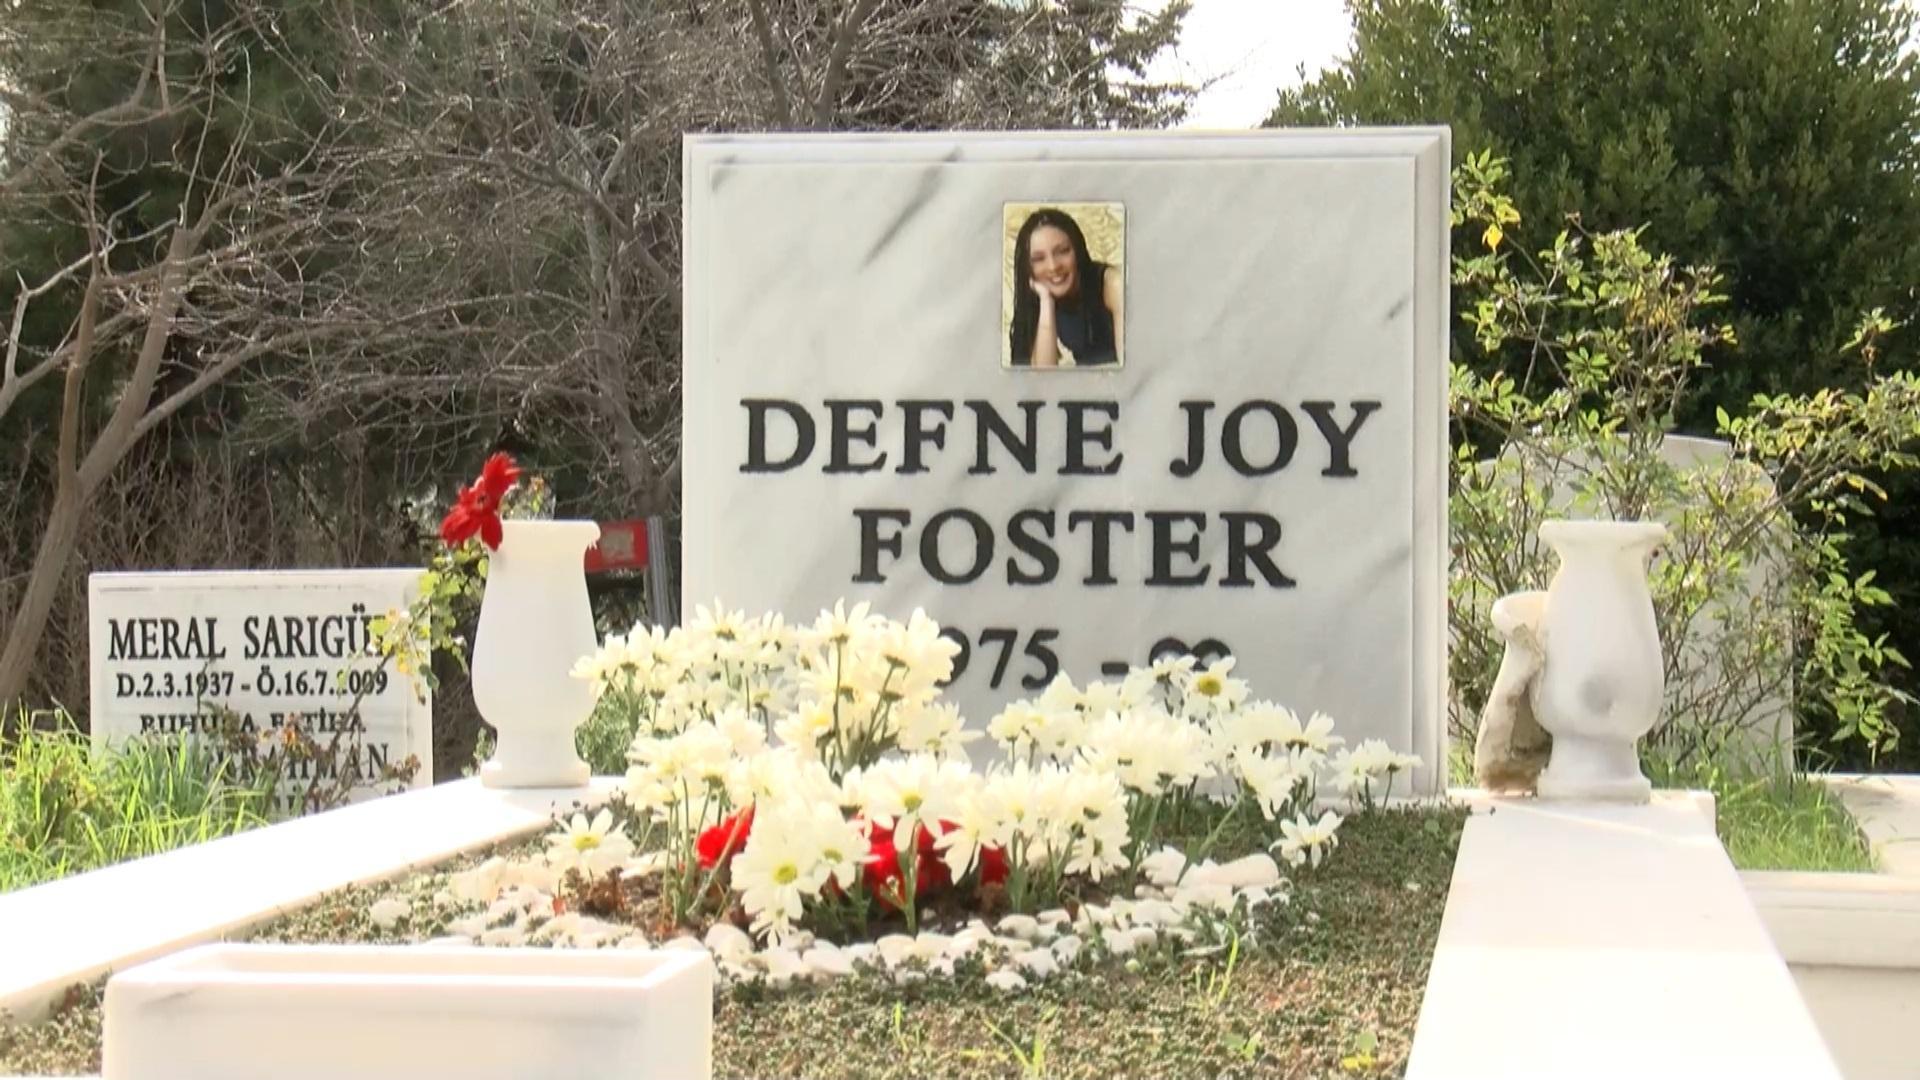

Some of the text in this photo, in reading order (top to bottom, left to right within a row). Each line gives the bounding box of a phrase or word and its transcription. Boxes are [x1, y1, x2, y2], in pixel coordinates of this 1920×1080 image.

[739, 398, 1382, 477] DEFNE JOY
[851, 508, 1296, 588] FOSTER
[107, 616, 226, 661] MERAL
[932, 626, 1061, 690] 975
[116, 671, 234, 698] D.2.3.1937
[140, 706, 367, 735] RUHUA FTİHA
